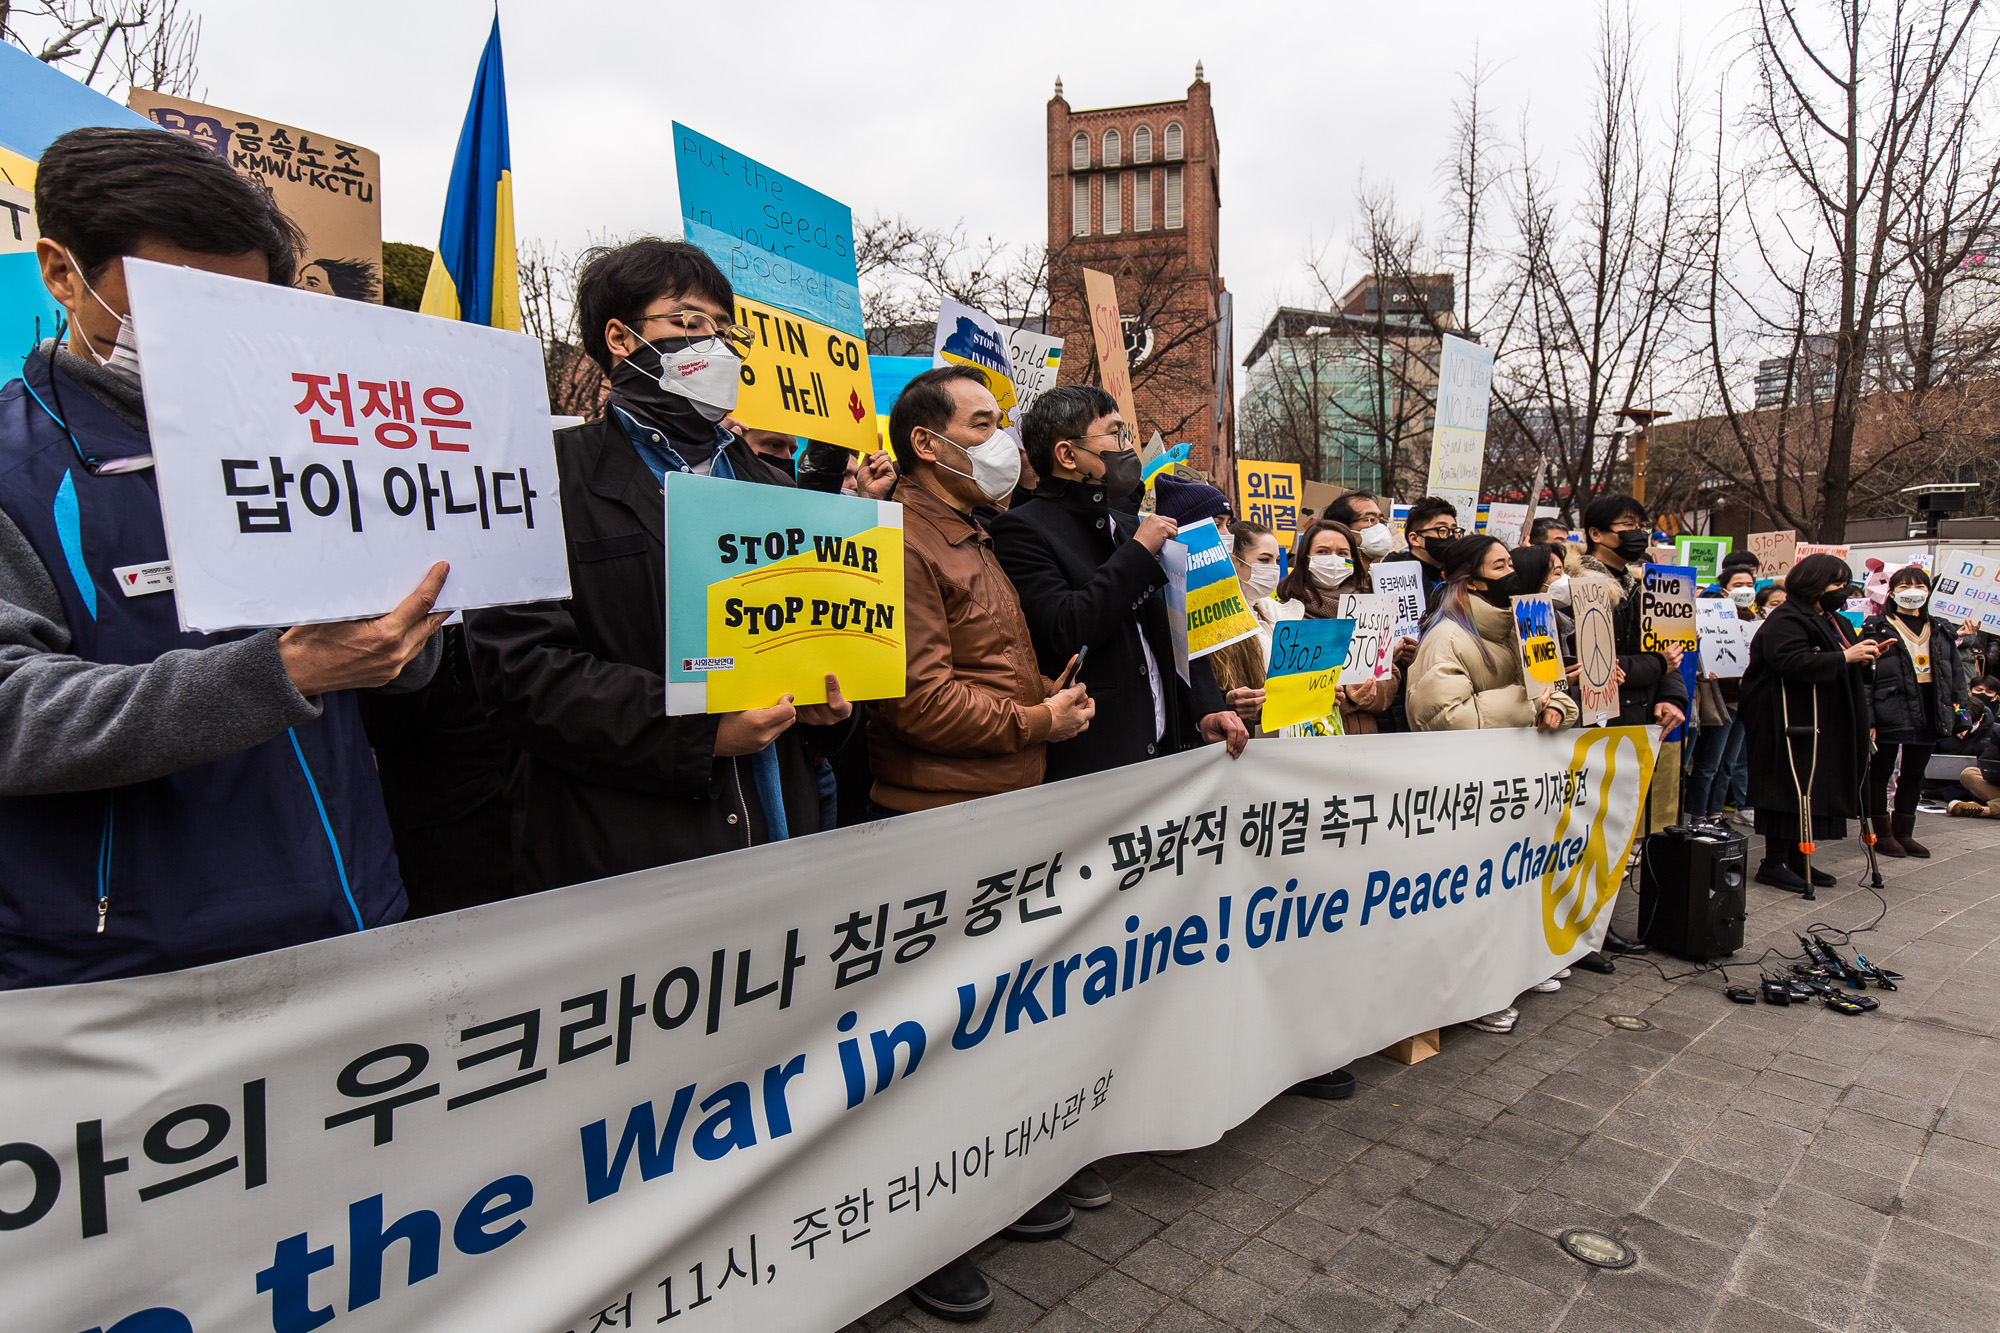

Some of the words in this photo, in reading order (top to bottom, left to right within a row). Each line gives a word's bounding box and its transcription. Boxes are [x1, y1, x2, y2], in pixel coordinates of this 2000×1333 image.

[234, 121, 365, 179] 금속노조
[741, 157, 784, 202] the
[690, 201, 715, 230] in
[730, 220, 795, 260] your
[741, 307, 809, 358] TIN
[827, 334, 860, 372] GO
[973, 332, 994, 351] STOP
[972, 351, 982, 364] IN
[291, 372, 472, 453] 전쟁은
[220, 456, 364, 533] 답이
[382, 463, 538, 531] 아니다
[1247, 472, 1295, 500] 외교
[1249, 503, 1297, 532] 해결
[717, 527, 806, 565] STOP
[813, 535, 879, 573] WAR
[1187, 541, 1228, 572] іженці
[1380, 573, 1419, 594] 우크라이나에
[1642, 567, 1680, 595] Give
[1960, 561, 1985, 578] no
[724, 596, 804, 635] STOP
[810, 597, 895, 634] PUTIN
[1396, 595, 1419, 623] 화를
[1642, 593, 1693, 618] Peace
[1516, 616, 1535, 640] WAR
[1641, 616, 1653, 633] a
[694, 657, 734, 667] 사회진보연대
[1532, 641, 1558, 664] WINNER
[1581, 684, 1602, 713] NOT
[324, 928, 806, 1147] 우크라이나
[829, 889, 949, 990] 침공
[963, 851, 1063, 938] 중단
[1107, 805, 1229, 892] 평화적
[1239, 797, 1311, 858] 해결
[1320, 793, 1380, 849] 촉구
[1387, 780, 1484, 840] 시민사회
[1489, 776, 1530, 824] 공동
[1534, 766, 1590, 816] 기자회견
[255, 1174, 535, 1333] the
[579, 1054, 807, 1205] War
[836, 1010, 928, 1112] in
[951, 895, 1233, 1051] Ukraine!
[1245, 878, 1350, 950] Give
[1359, 863, 1469, 928] Peace
[1475, 858, 1493, 898] a
[1501, 823, 1590, 891] Chance!
[655, 1232, 778, 1326] 11시,
[789, 1186, 875, 1261] 주한
[887, 1135, 995, 1215] 러시아
[1003, 1092, 1086, 1160] 대사관
[1090, 1068, 1114, 1110] 앞
